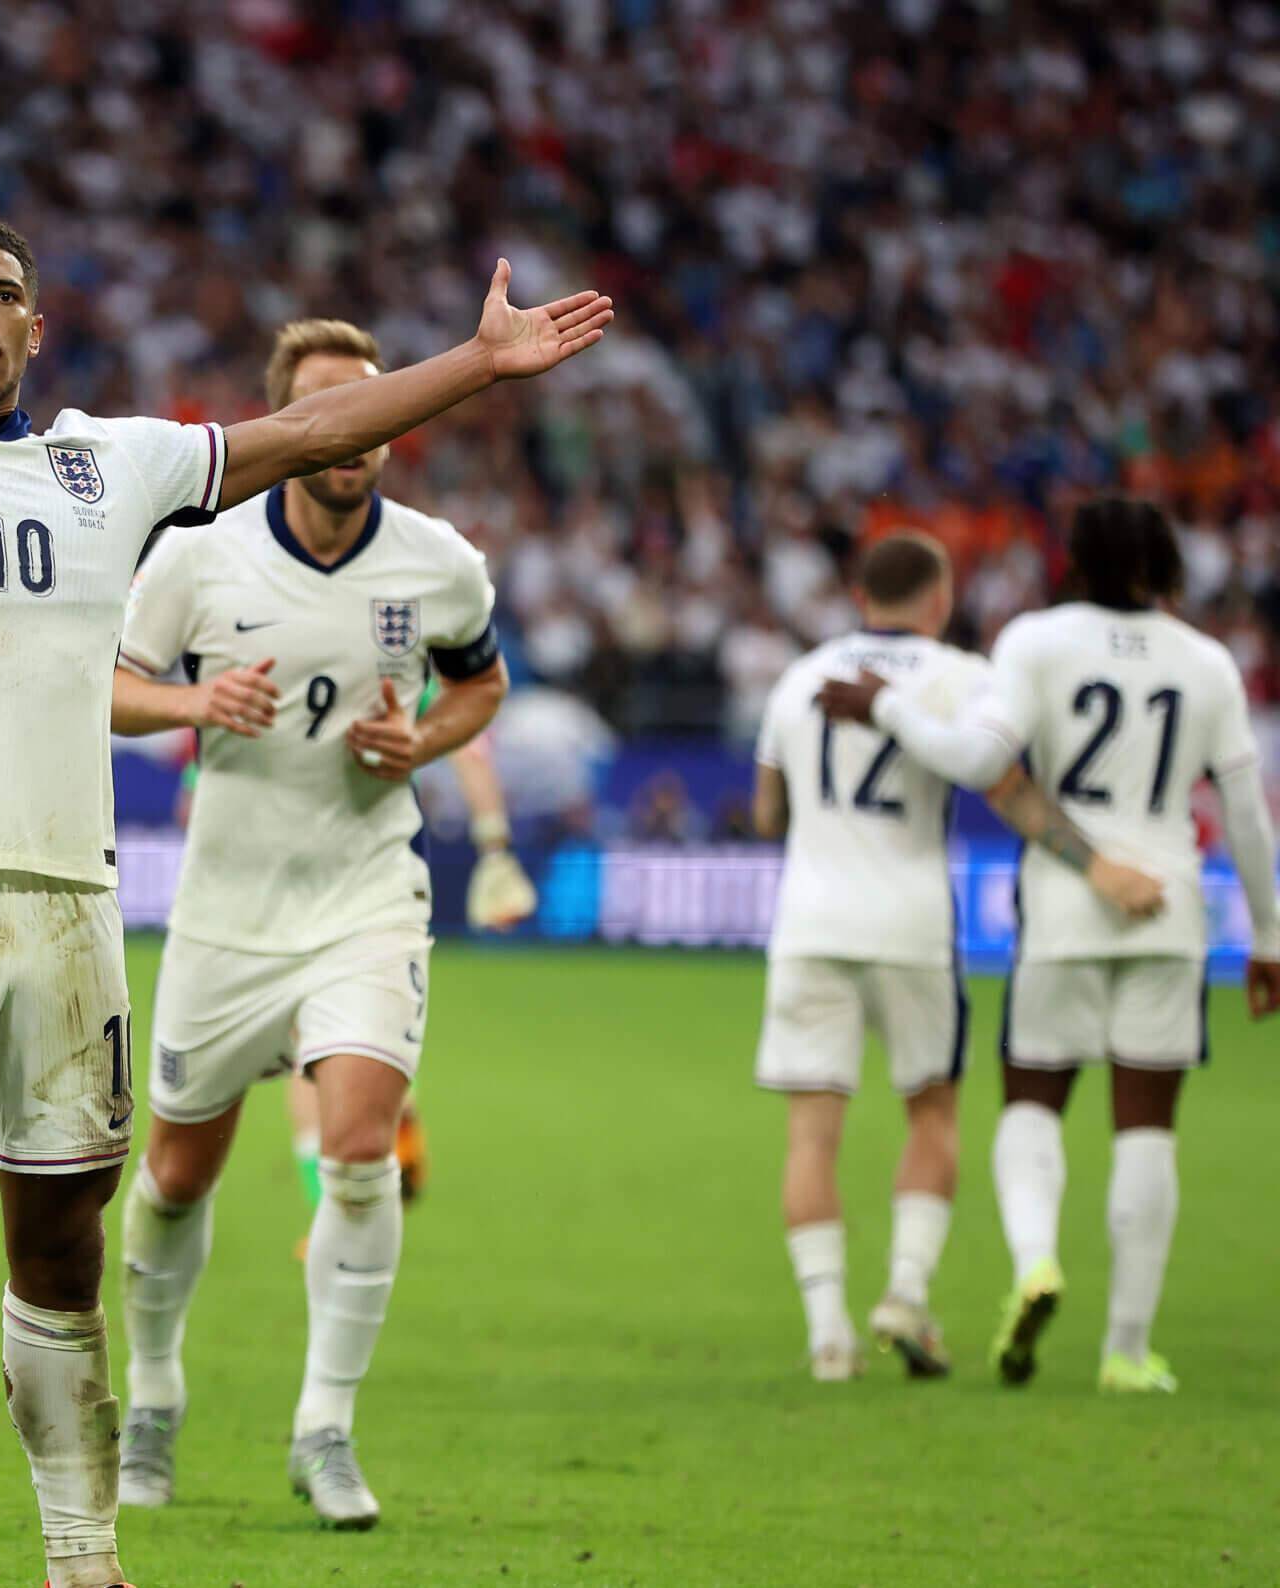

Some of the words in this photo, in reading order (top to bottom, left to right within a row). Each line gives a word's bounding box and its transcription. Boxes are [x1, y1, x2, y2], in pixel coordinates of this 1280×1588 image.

[305, 676, 337, 740] 9
[811, 692, 905, 820] 12
[1058, 681, 1182, 814] 21
